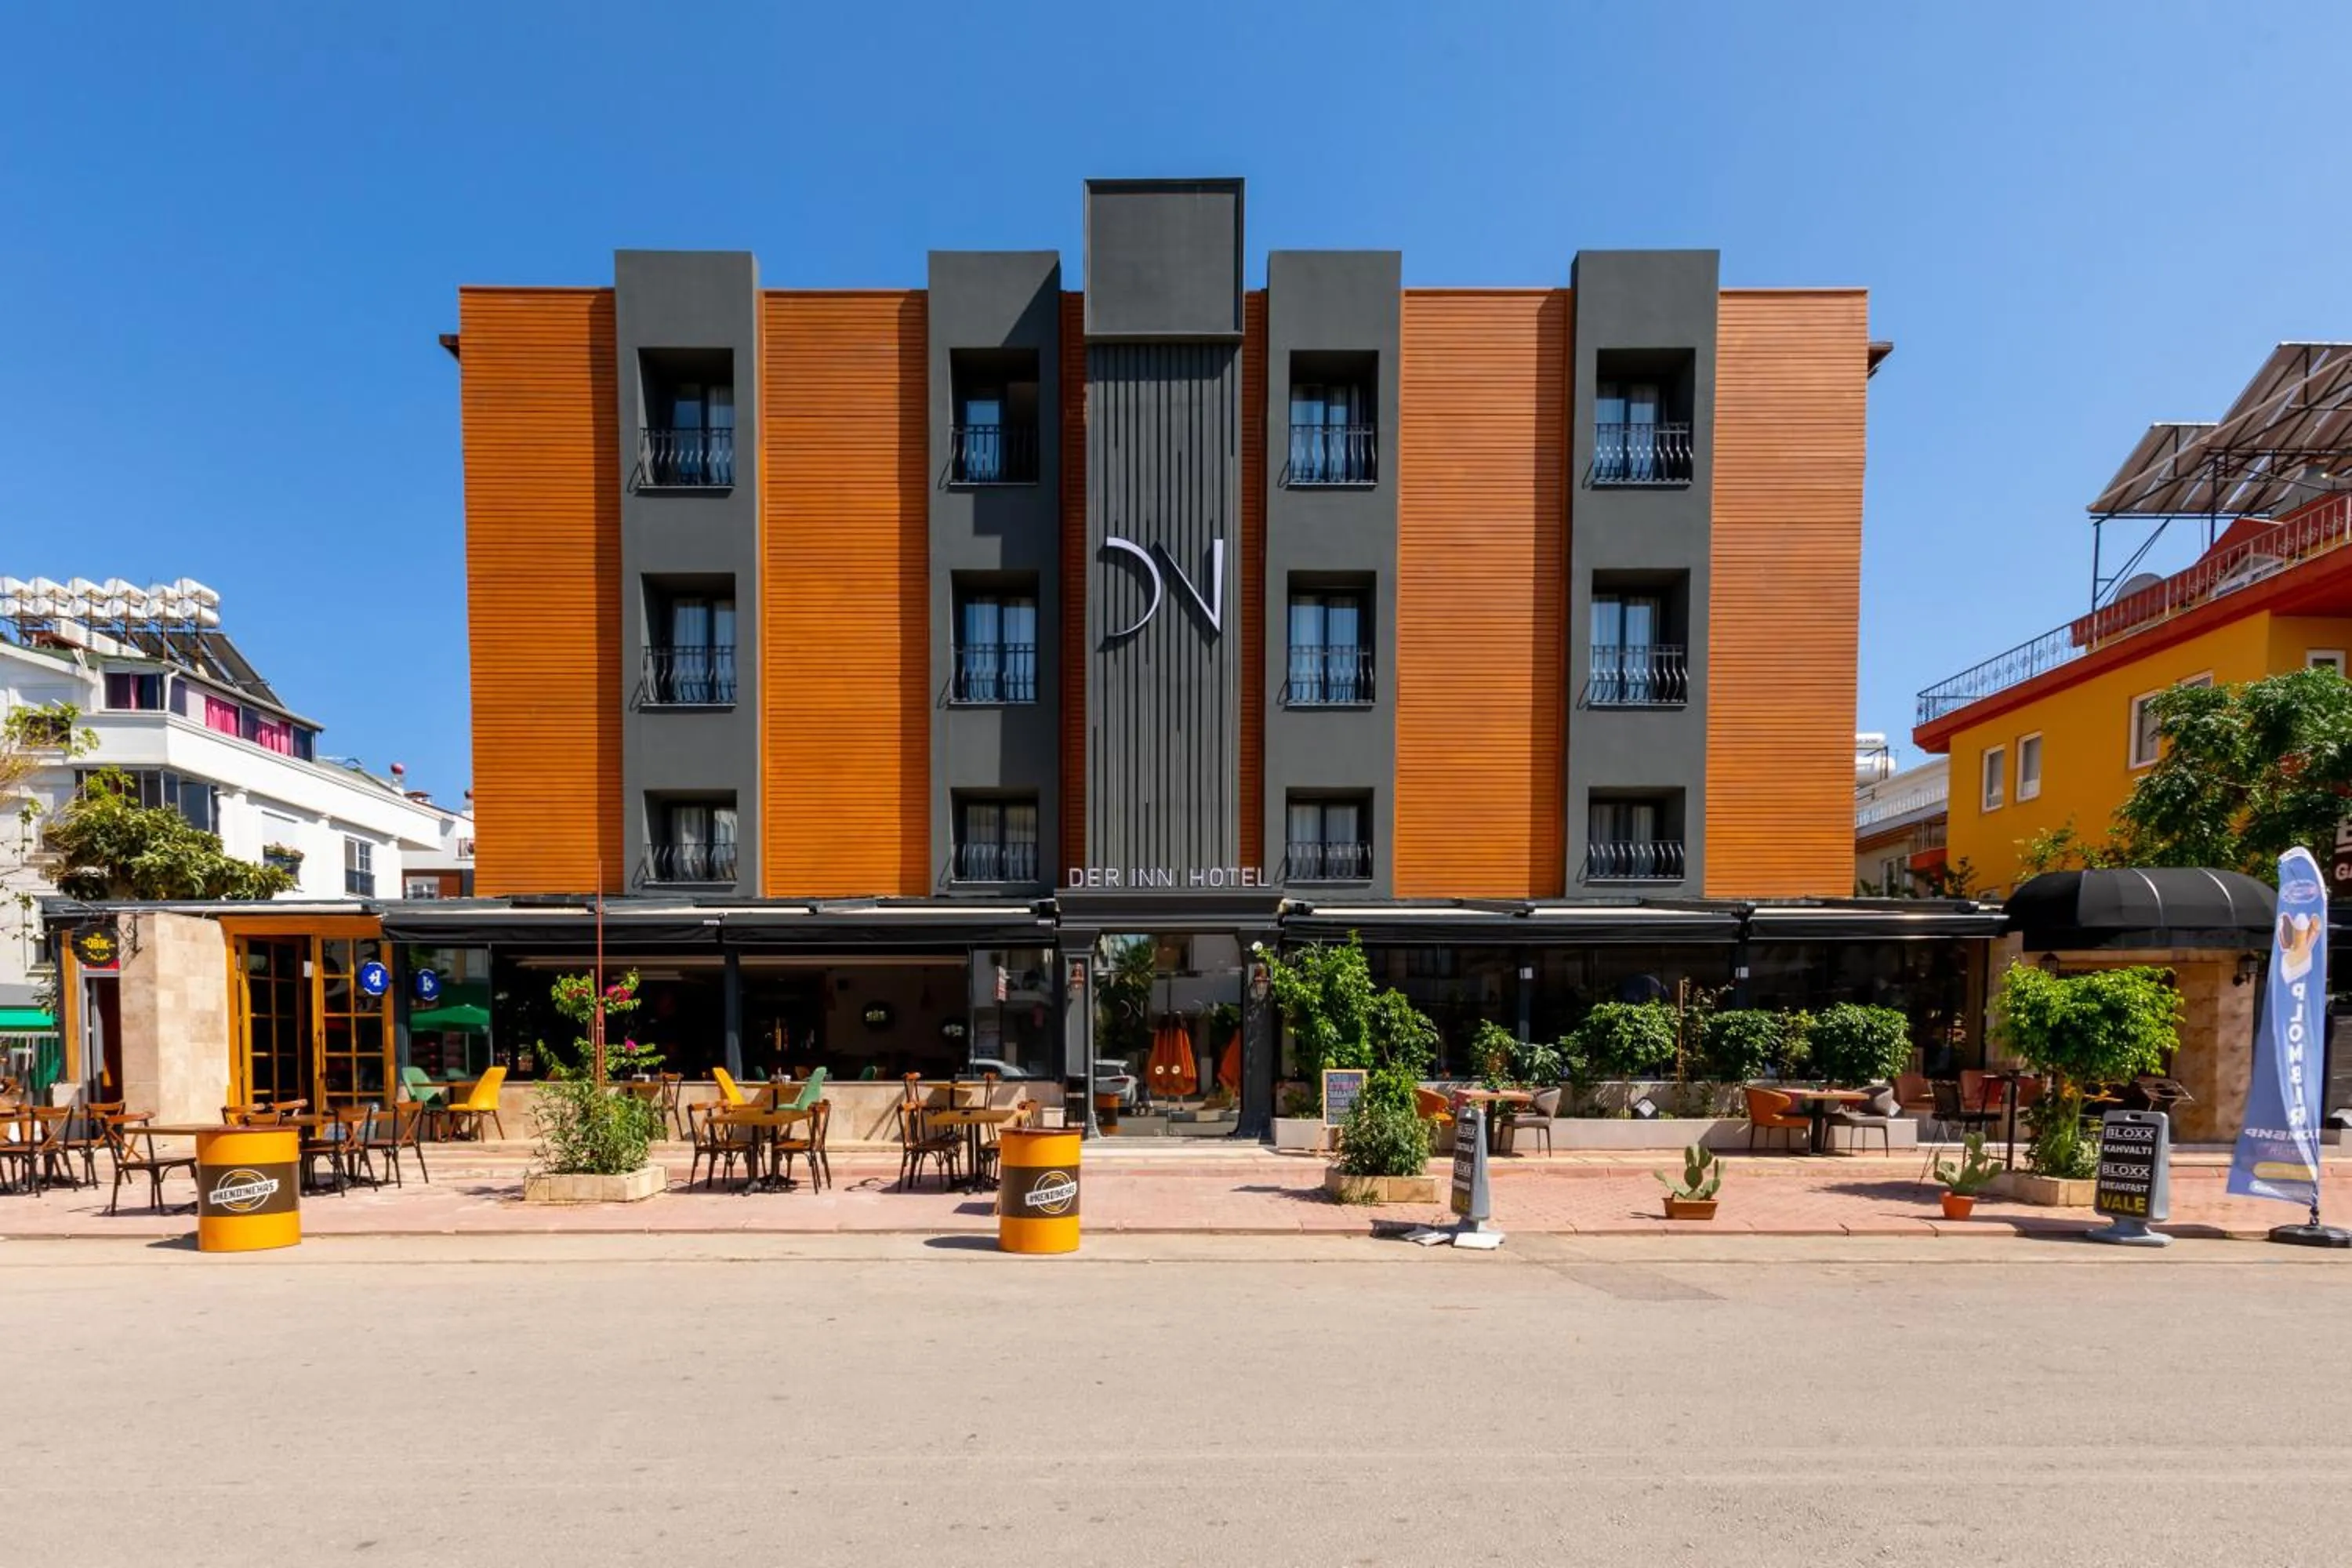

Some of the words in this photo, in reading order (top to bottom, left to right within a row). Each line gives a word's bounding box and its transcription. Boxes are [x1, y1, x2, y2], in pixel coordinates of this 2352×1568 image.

[1068, 867, 1120, 888] DER
[1131, 867, 1174, 888] INN
[1189, 866, 1271, 887] HOTEL
[2105, 1127, 2154, 1140] BLOXX
[2102, 1163, 2150, 1178] BLOXX
[2102, 1192, 2146, 1213] VALE
